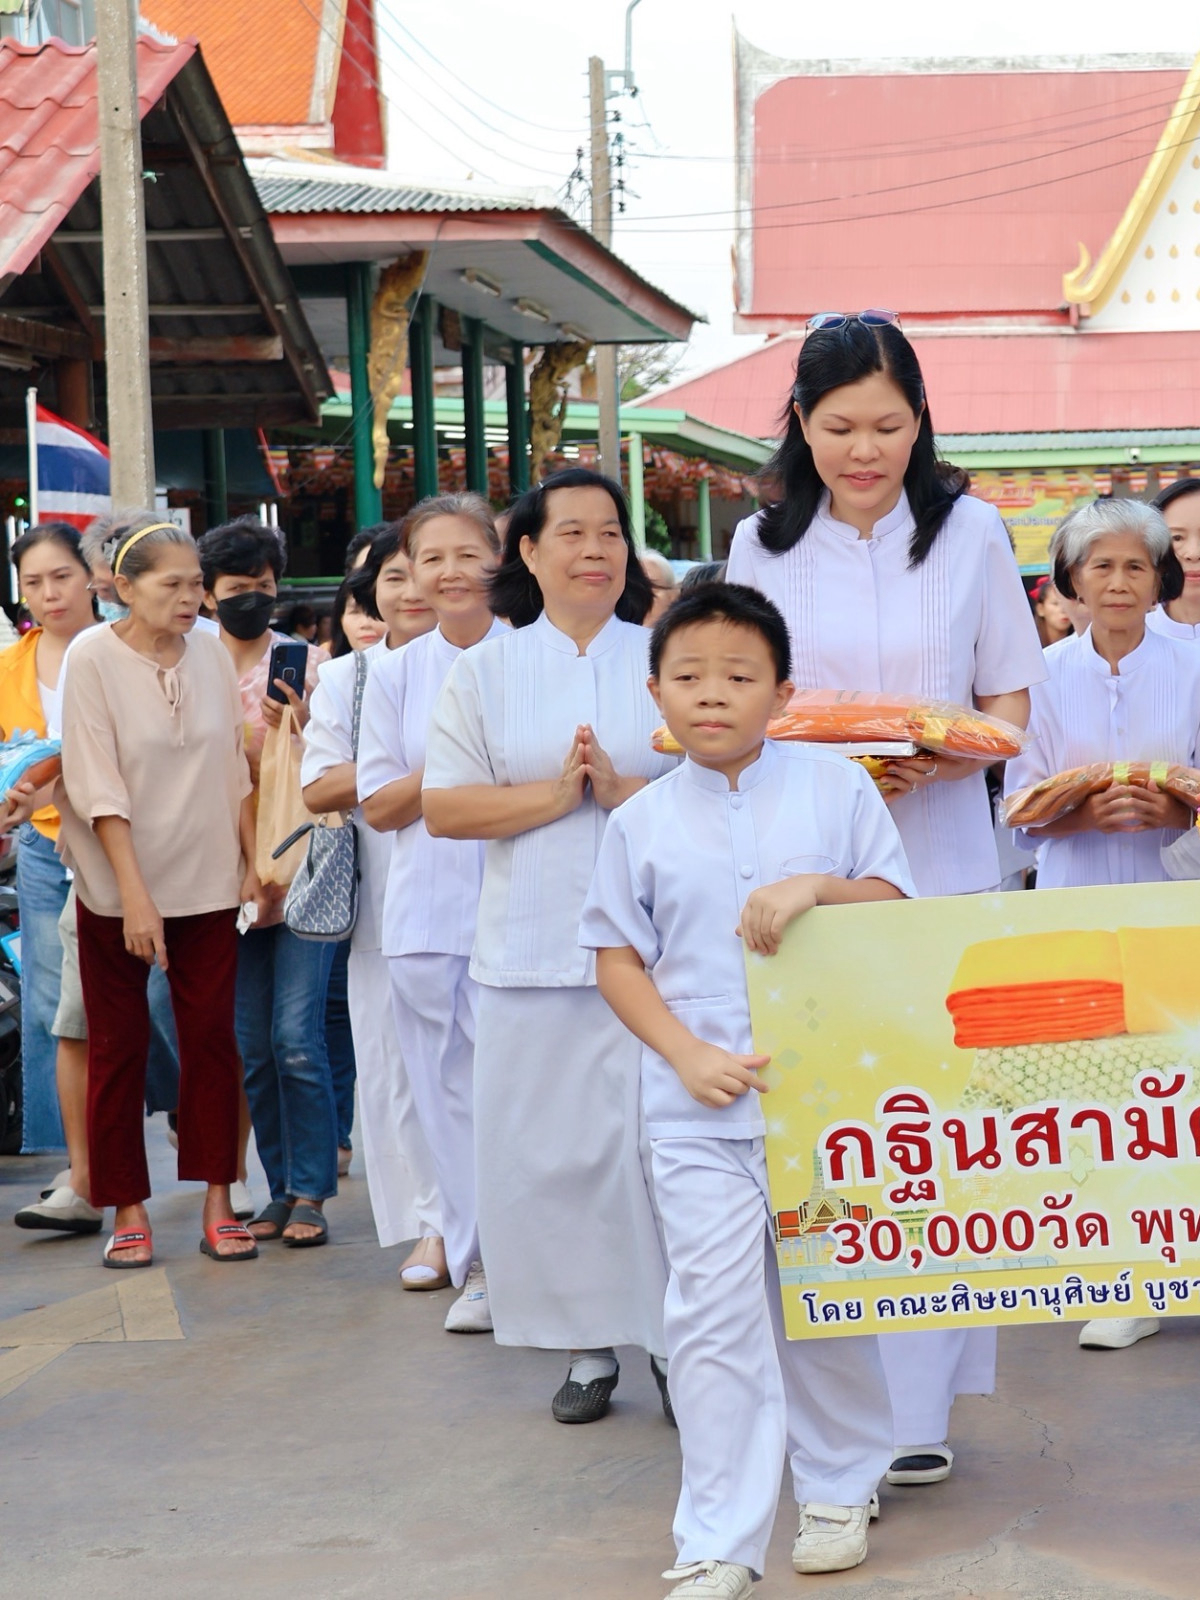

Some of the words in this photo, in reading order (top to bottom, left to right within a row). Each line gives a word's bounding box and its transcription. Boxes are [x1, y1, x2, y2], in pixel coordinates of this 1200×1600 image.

[833, 1192, 1111, 1270] 30,000วัด
[801, 1292, 863, 1324] โดย
[876, 1268, 1132, 1319] คณะศิษยานุศิษย์
